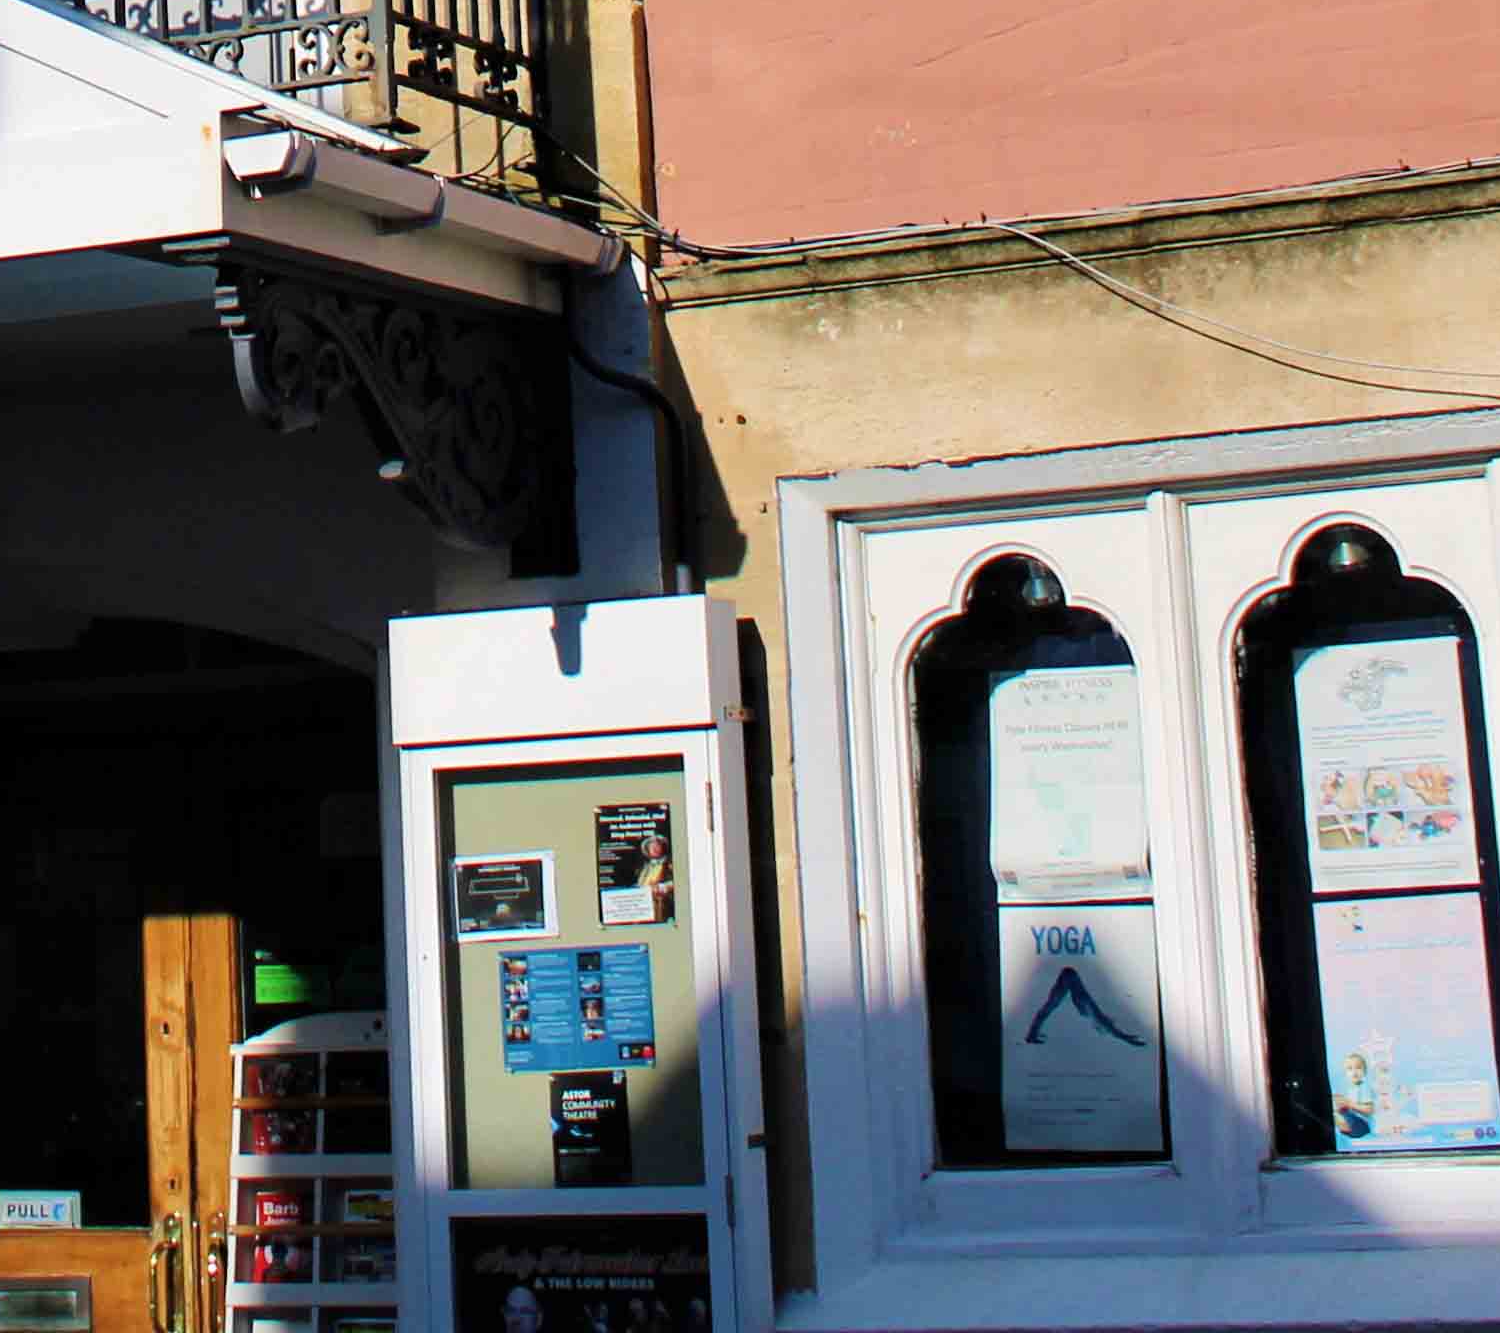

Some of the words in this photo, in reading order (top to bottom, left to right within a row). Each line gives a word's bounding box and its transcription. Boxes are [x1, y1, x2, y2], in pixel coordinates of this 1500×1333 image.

[1031, 925, 1097, 955] YOGA
[7, 1203, 49, 1219] PULL
[263, 1200, 299, 1217] Barb
